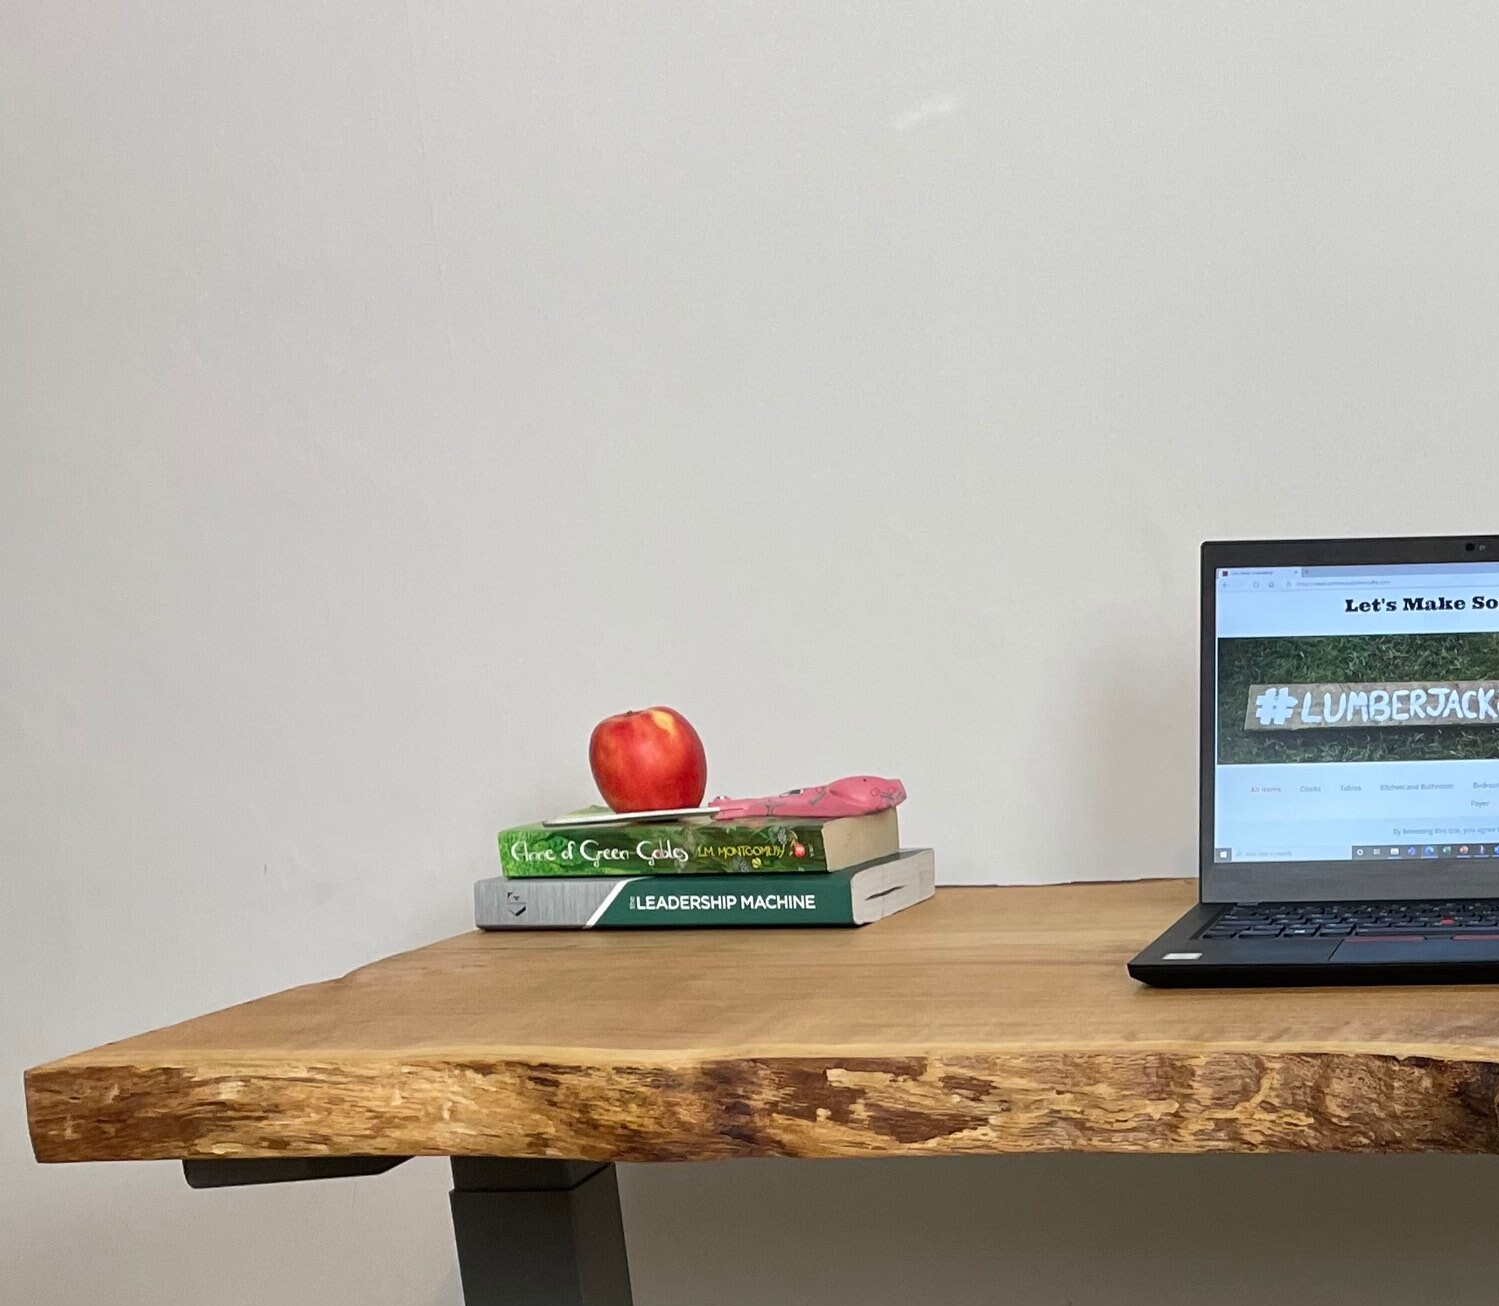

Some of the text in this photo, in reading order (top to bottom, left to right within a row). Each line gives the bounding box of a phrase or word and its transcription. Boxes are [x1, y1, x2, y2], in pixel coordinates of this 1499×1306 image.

[1344, 598, 1397, 612] Let's
[1402, 597, 1466, 611] Make
[511, 839, 689, 867] Anne of Green Gables
[636, 894, 816, 910] LEADERSHIP MACHINE
